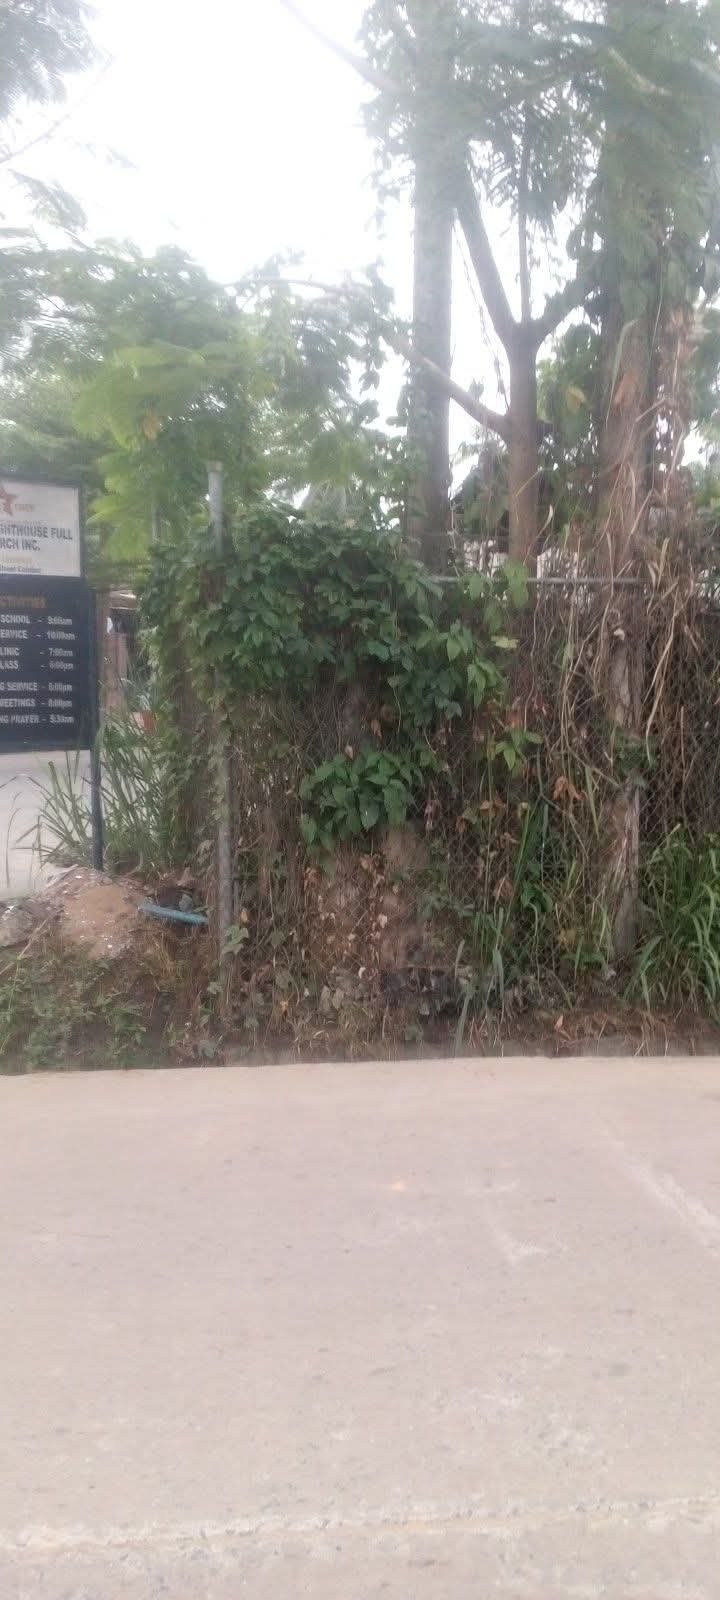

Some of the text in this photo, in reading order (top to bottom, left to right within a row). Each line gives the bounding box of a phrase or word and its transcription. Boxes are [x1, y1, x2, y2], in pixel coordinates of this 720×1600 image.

[50, 527, 73, 540] FULL
[1, 614, 31, 624] SCHOOL
[7, 682, 38, 691] SERVICE
[11, 715, 40, 724] PRAYER
